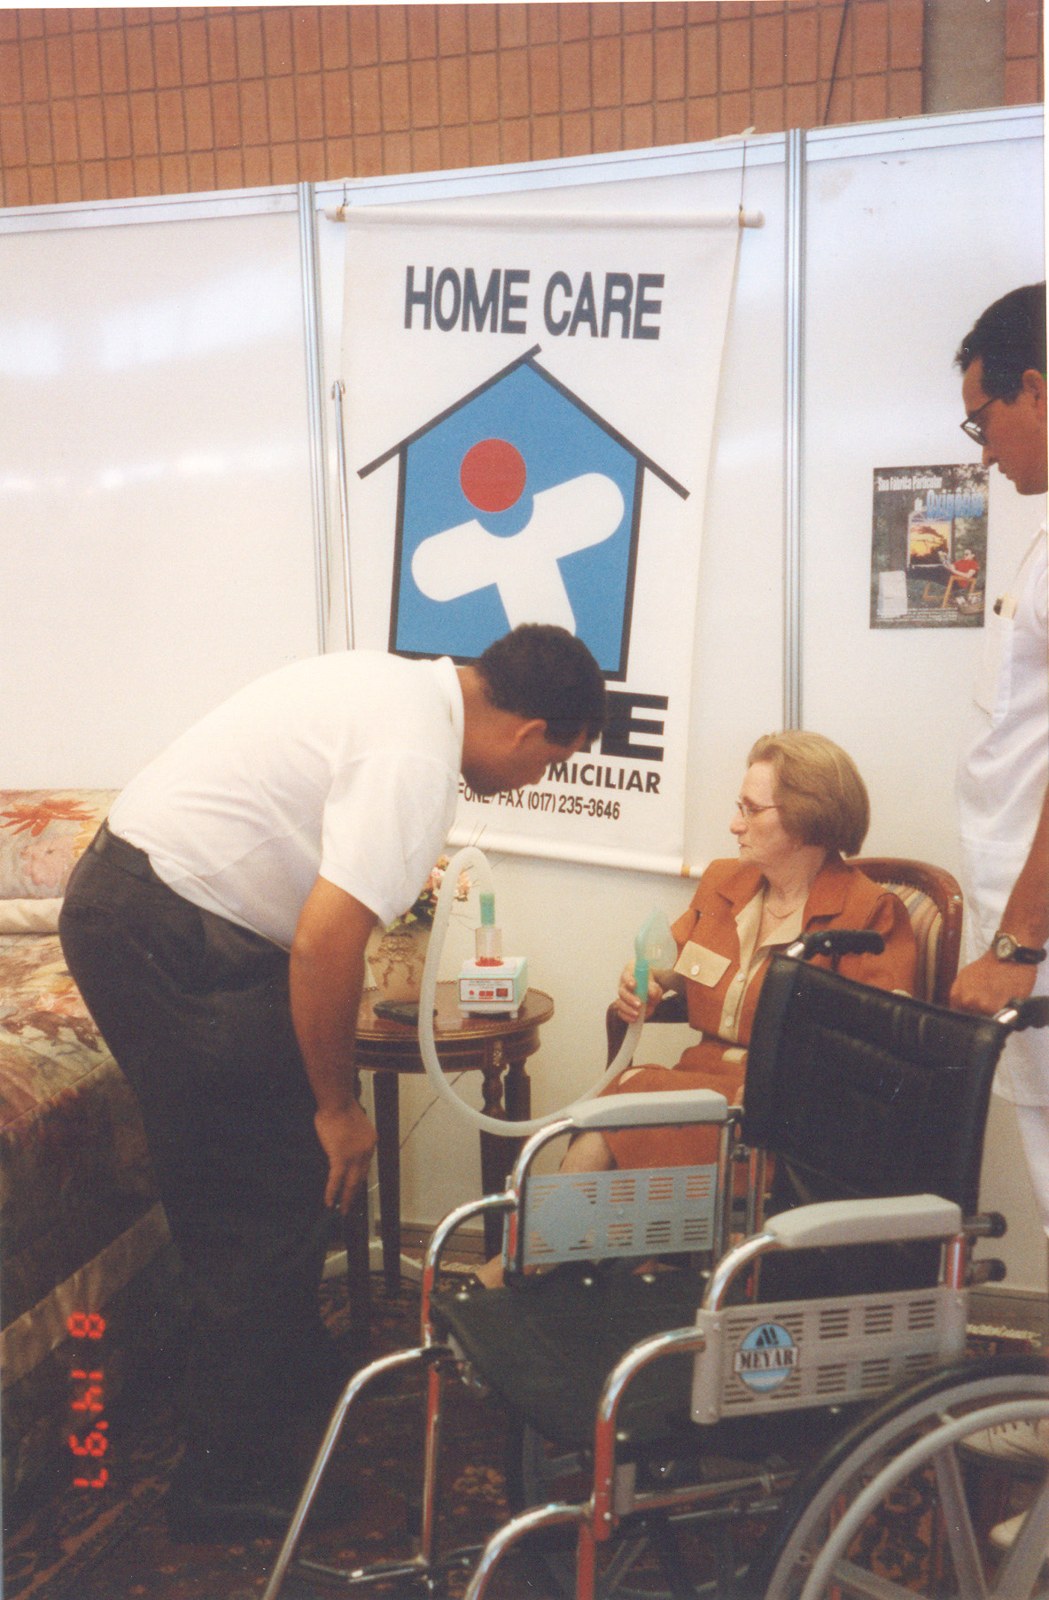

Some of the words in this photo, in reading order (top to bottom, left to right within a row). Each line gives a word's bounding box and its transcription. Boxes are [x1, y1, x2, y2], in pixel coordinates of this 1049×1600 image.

[404, 265, 530, 334] HOME
[543, 270, 665, 340] CARE
[527, 791, 556, 814] (017)
[558, 795, 621, 820] 235-3646
